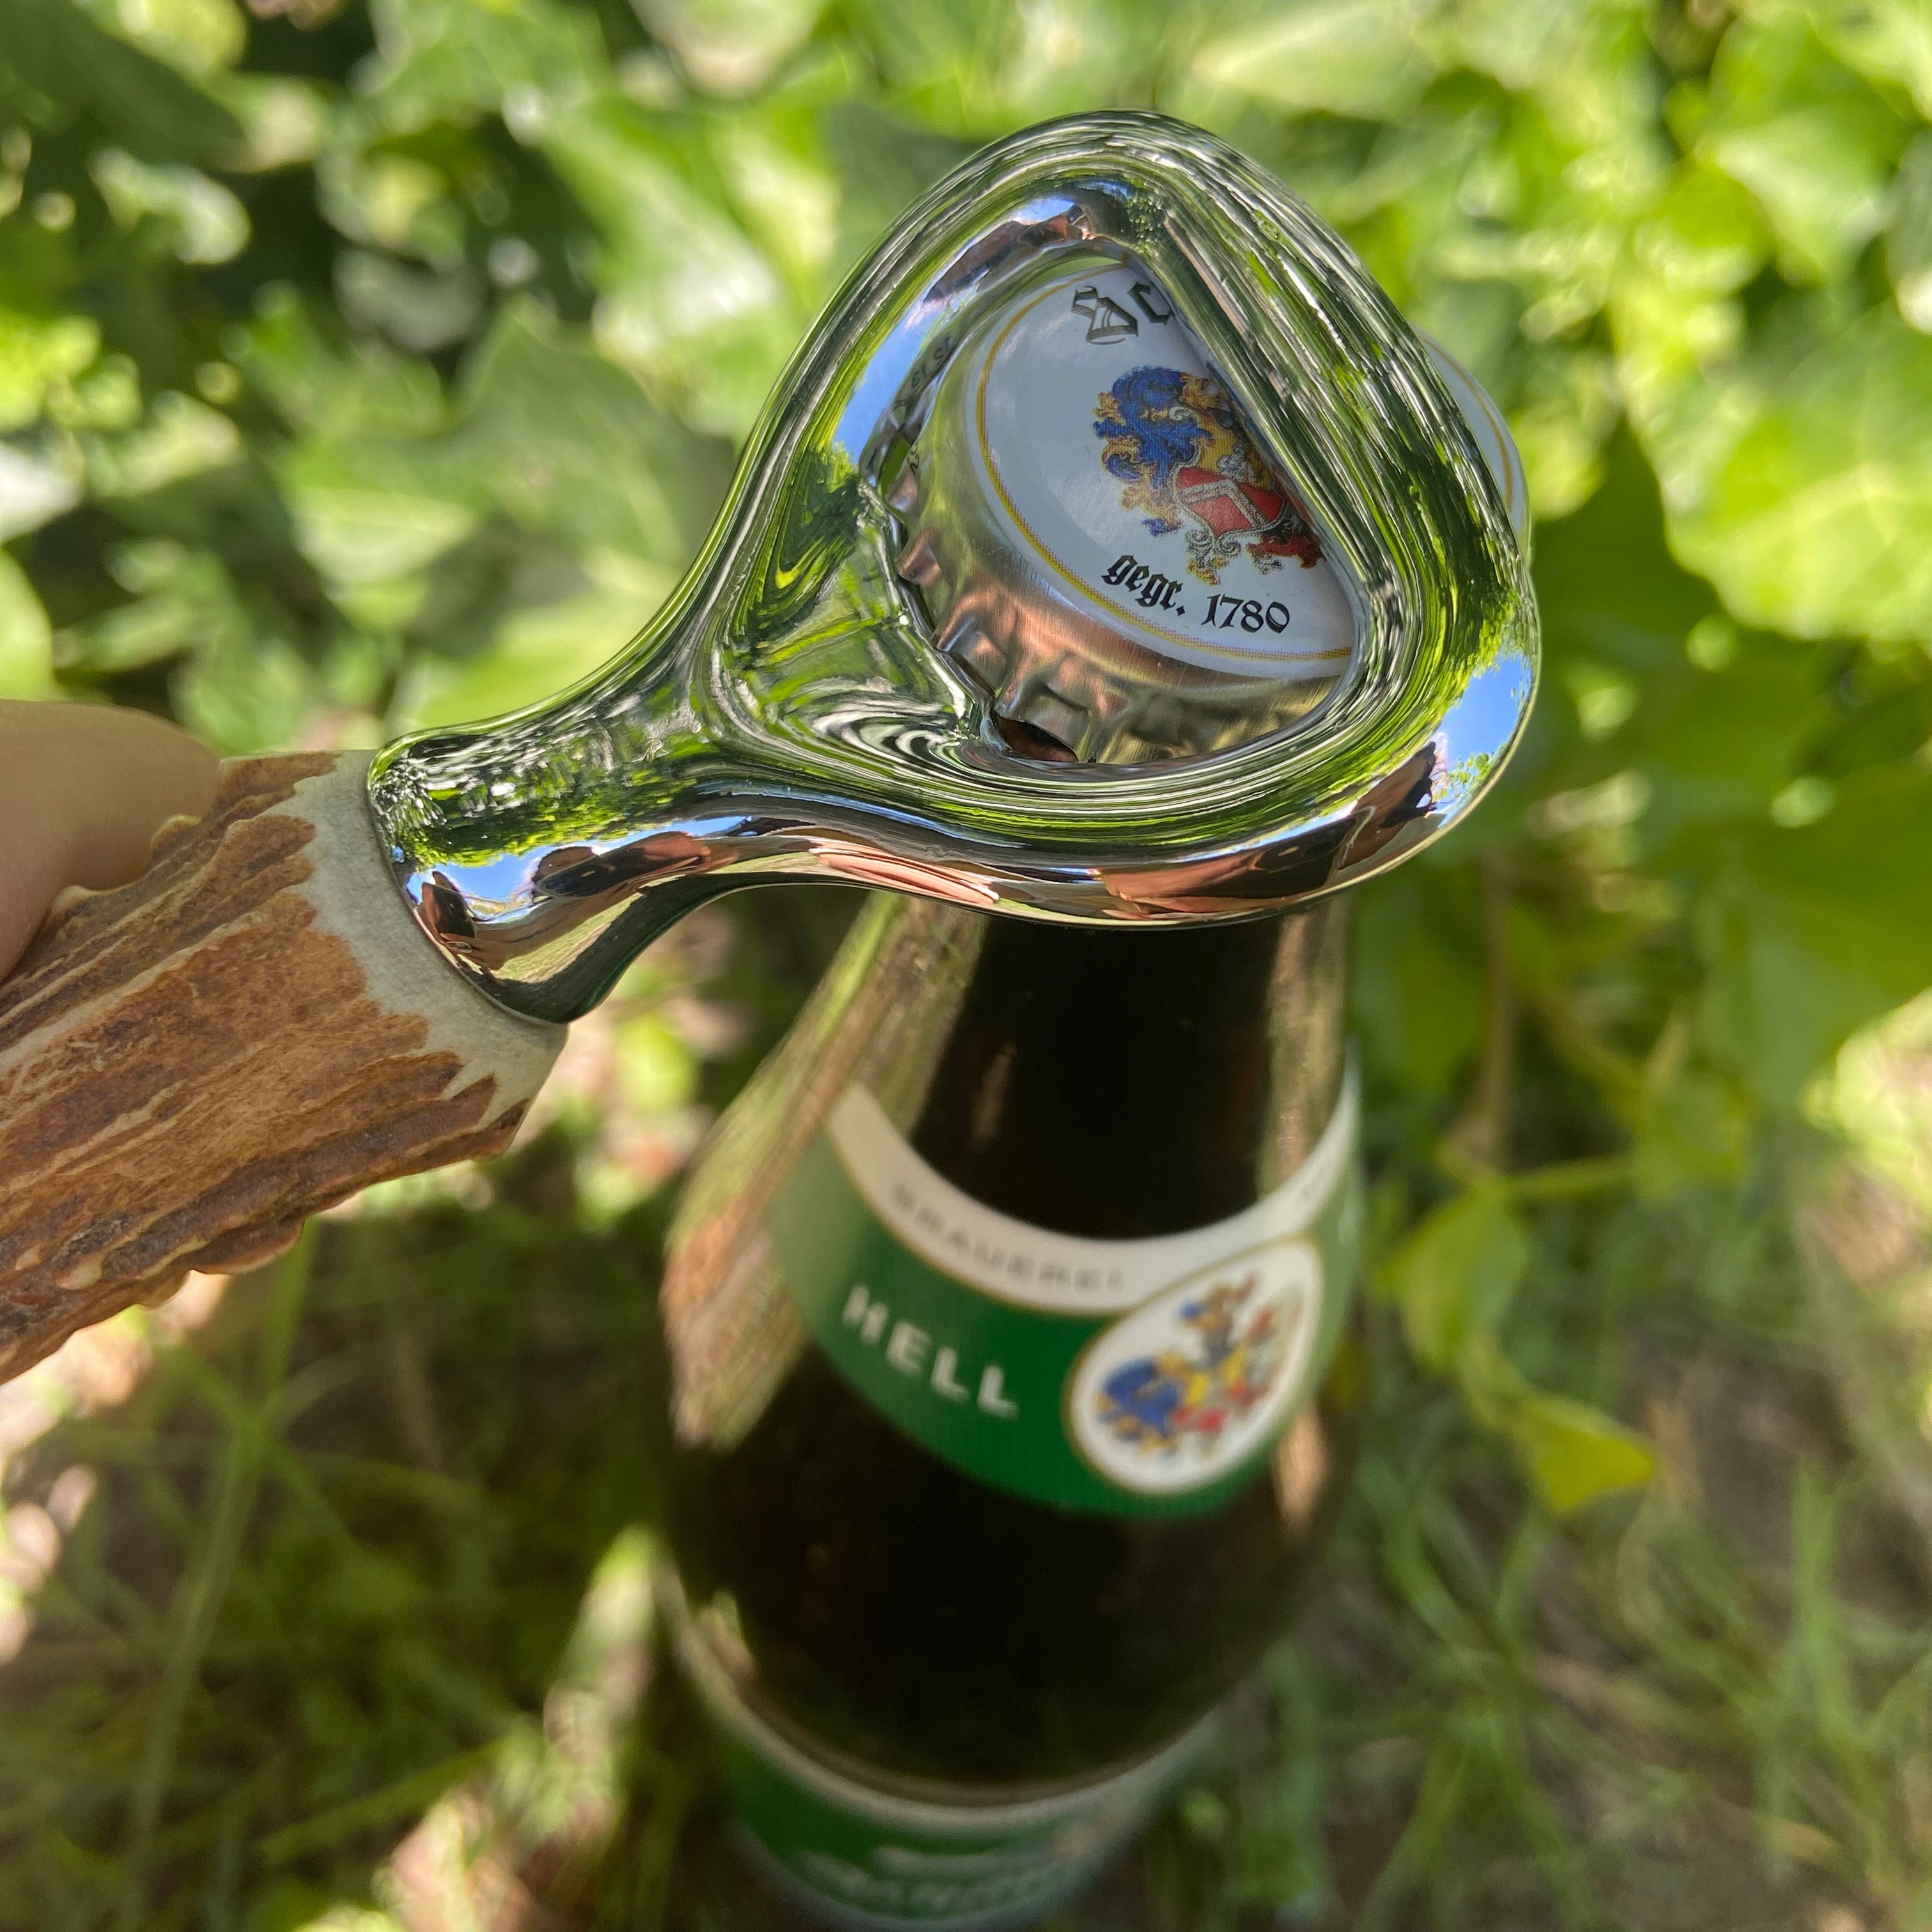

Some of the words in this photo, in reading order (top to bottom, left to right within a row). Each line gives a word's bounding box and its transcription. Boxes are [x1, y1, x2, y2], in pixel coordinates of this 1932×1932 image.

[1101, 554, 1186, 617] gegr.
[1200, 593, 1291, 634] 1780
[839, 1282, 1020, 1421] HELL
